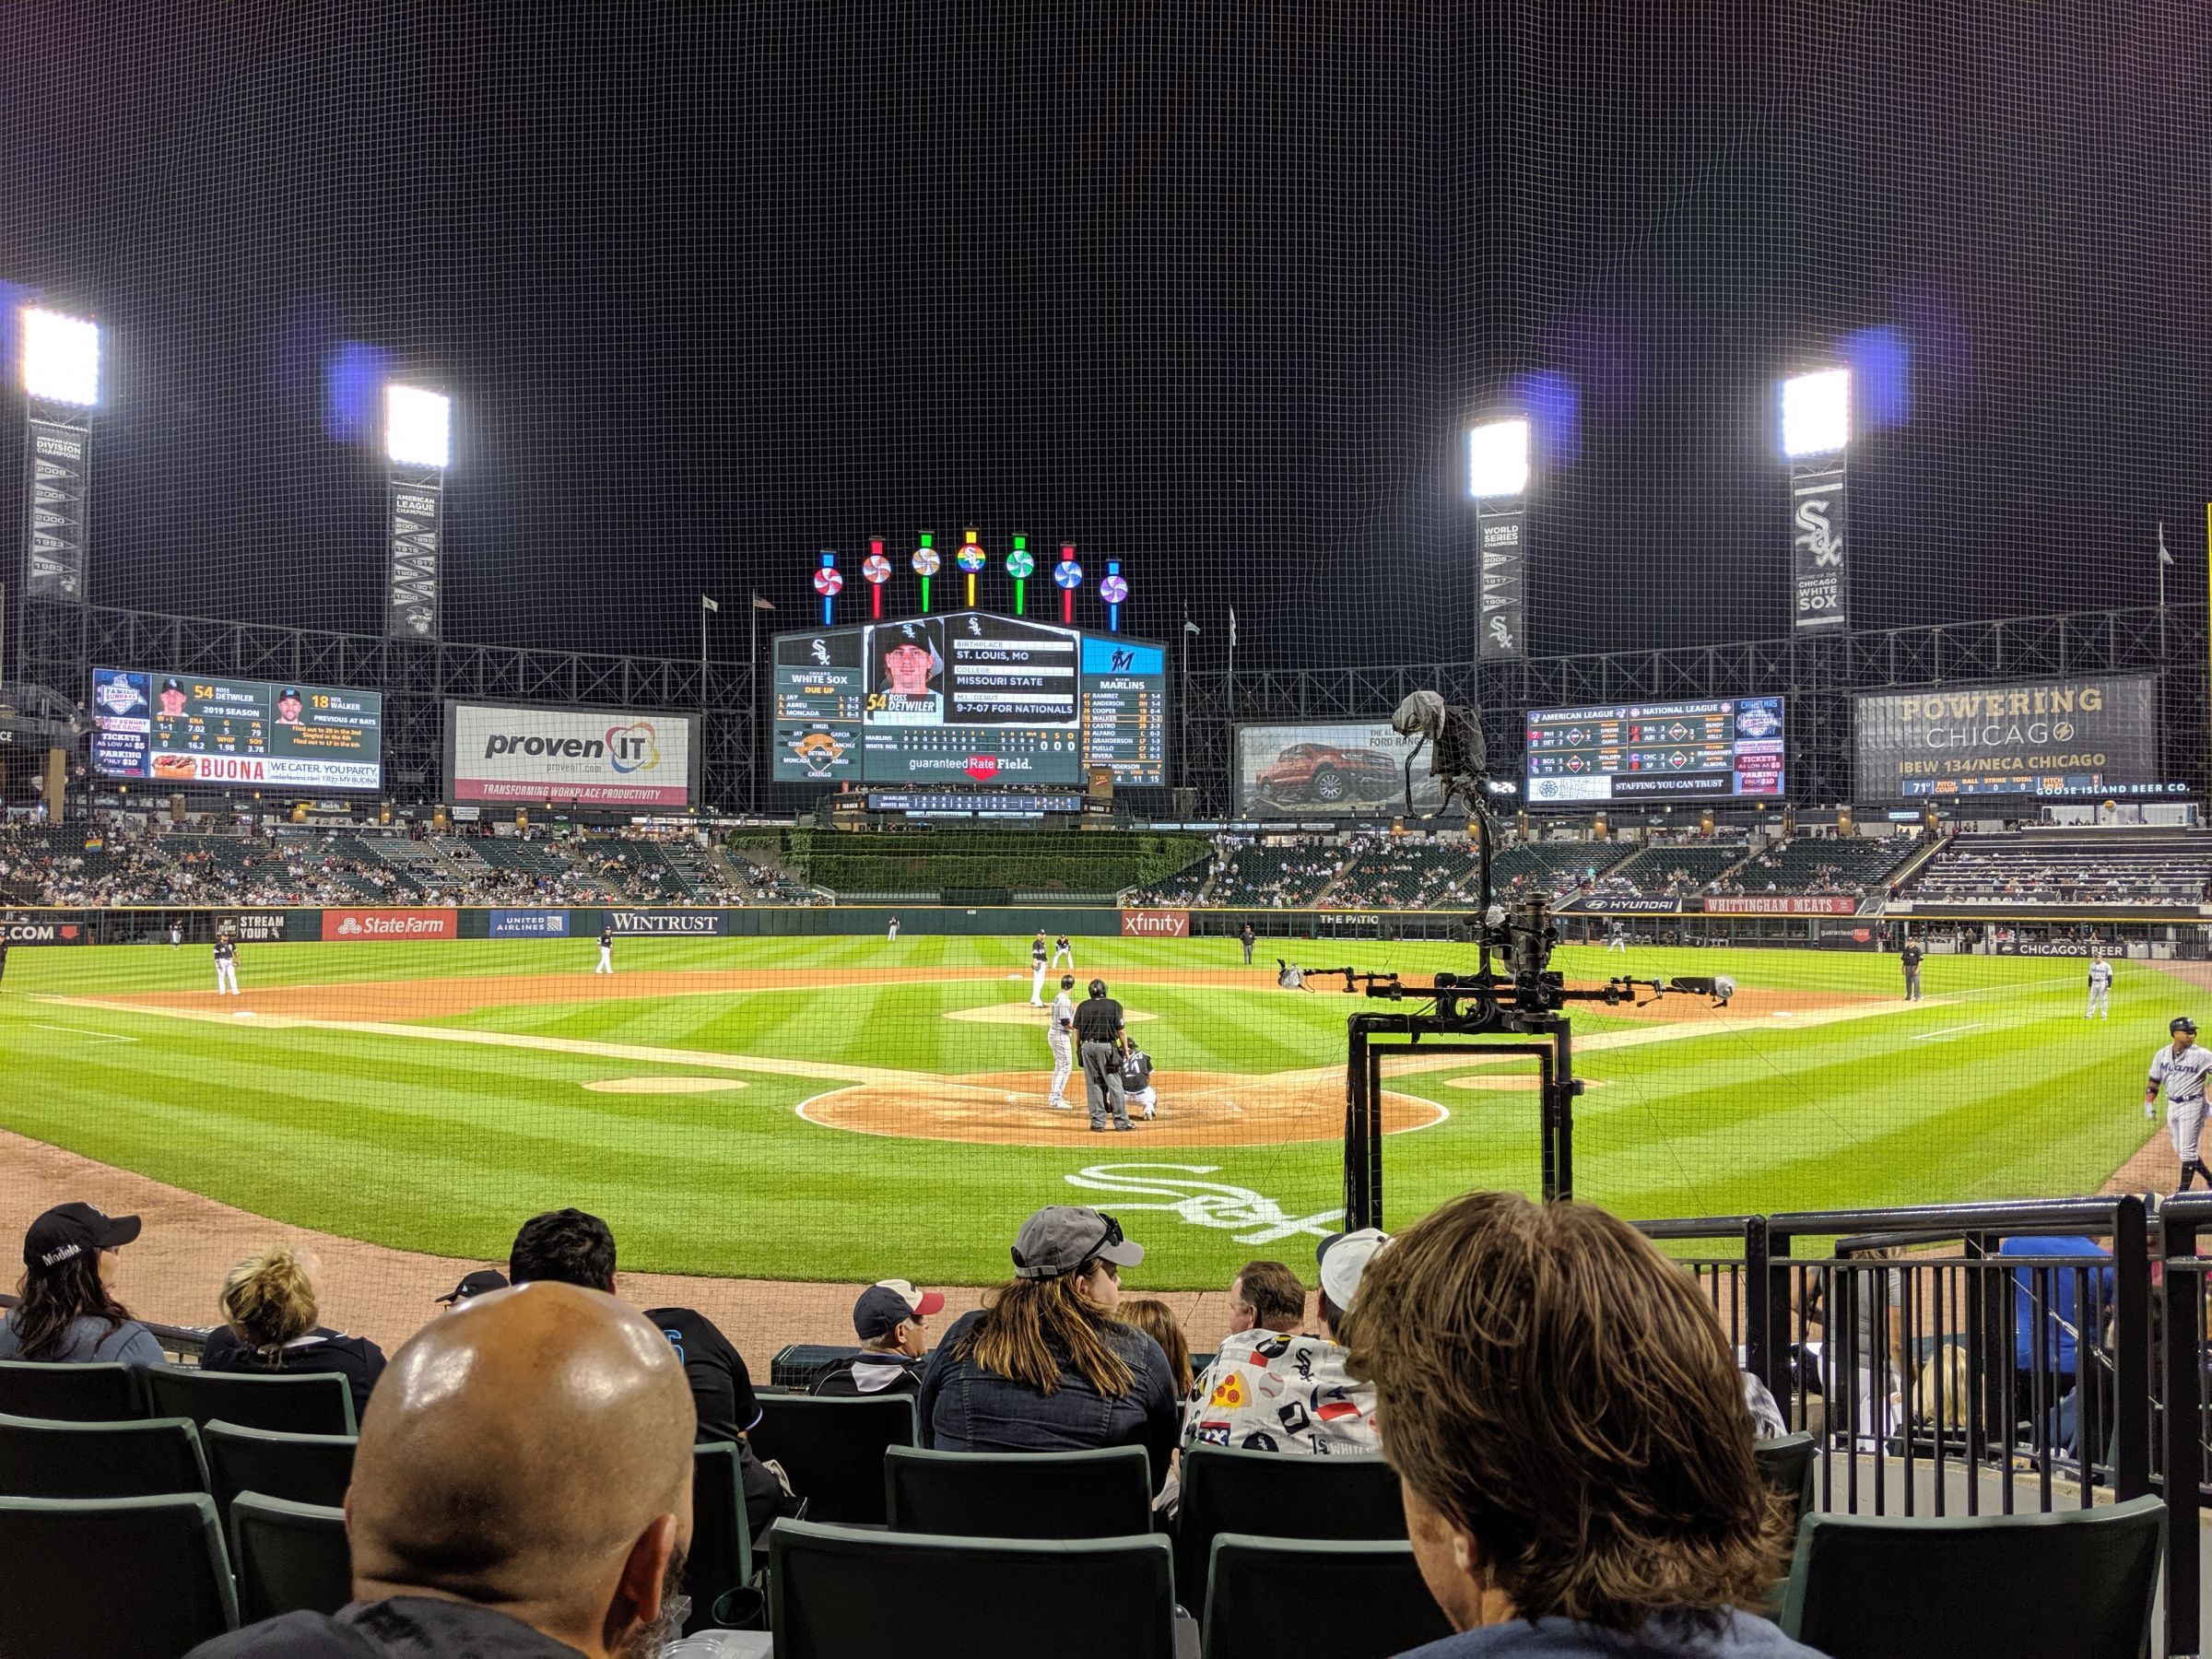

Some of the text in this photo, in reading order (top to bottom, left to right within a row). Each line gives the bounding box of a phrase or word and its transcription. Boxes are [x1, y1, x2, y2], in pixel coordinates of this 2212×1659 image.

[37, 441, 80, 453] DIVISION
[37, 448, 80, 460] CHAMPIONS
[38, 465, 66, 476] 2008
[396, 494, 434, 504] AMERICAN
[396, 500, 434, 512] LEAGUE
[396, 508, 434, 517] CHAMPIONS
[36, 514, 65, 524] 2000
[1484, 525, 1518, 535] WORLD
[1485, 533, 1518, 543] SERIES
[1798, 578, 1837, 588] CHICAGO
[1799, 585, 1837, 596] WHITE
[1800, 594, 1837, 610] SOX
[957, 651, 972, 659] ST.
[975, 652, 1009, 661] LOUIS,
[792, 675, 824, 684] WHITE
[957, 677, 1043, 686] MISSOURI STATE
[1100, 681, 1145, 689] MARLINS
[194, 685, 214, 699] 54
[216, 693, 253, 702] DETWILER
[312, 696, 328, 708] 18
[867, 694, 887, 710] 54
[331, 702, 360, 711] WALKER
[888, 701, 935, 711] DETWILER
[957, 704, 989, 712] 9-7-07
[1016, 705, 1073, 713] NATIONALS
[1900, 688, 2103, 721] POWERING
[226, 709, 259, 717] SEASON
[1643, 706, 1684, 714] NATIONAL
[1542, 712, 1582, 721] AMERICAN
[485, 735, 645, 759] proven IT
[1370, 738, 1393, 747] FORD
[100, 750, 141, 759] PARKING
[271, 762, 287, 771] WE
[324, 766, 346, 774] YOU
[547, 762, 602, 773] provenIT.com
[910, 759, 1032, 771] guaranteed Rate Field.
[1899, 753, 2106, 774] IBEW 134/NECA CHICAGO
[201, 759, 264, 780] BUONA
[1616, 782, 1655, 790] STAFFING
[2037, 783, 2190, 795] GOOSE ISLAND BEER CO.
[483, 784, 661, 800] TRANSFORMING WORKPLACE PRODUCTIVITY
[1610, 901, 1674, 910] HYUNDAI
[1708, 899, 1787, 912] WHITTINGHAM
[1794, 899, 1832, 912] MEATS
[241, 916, 284, 927] STREAM
[1125, 912, 1185, 935] xfinity
[1320, 915, 1378, 924] THE PATIO
[241, 927, 268, 938] YOUR
[1821, 929, 1854, 937] guaranteed
[2020, 945, 2087, 955] CHICAGO'S
